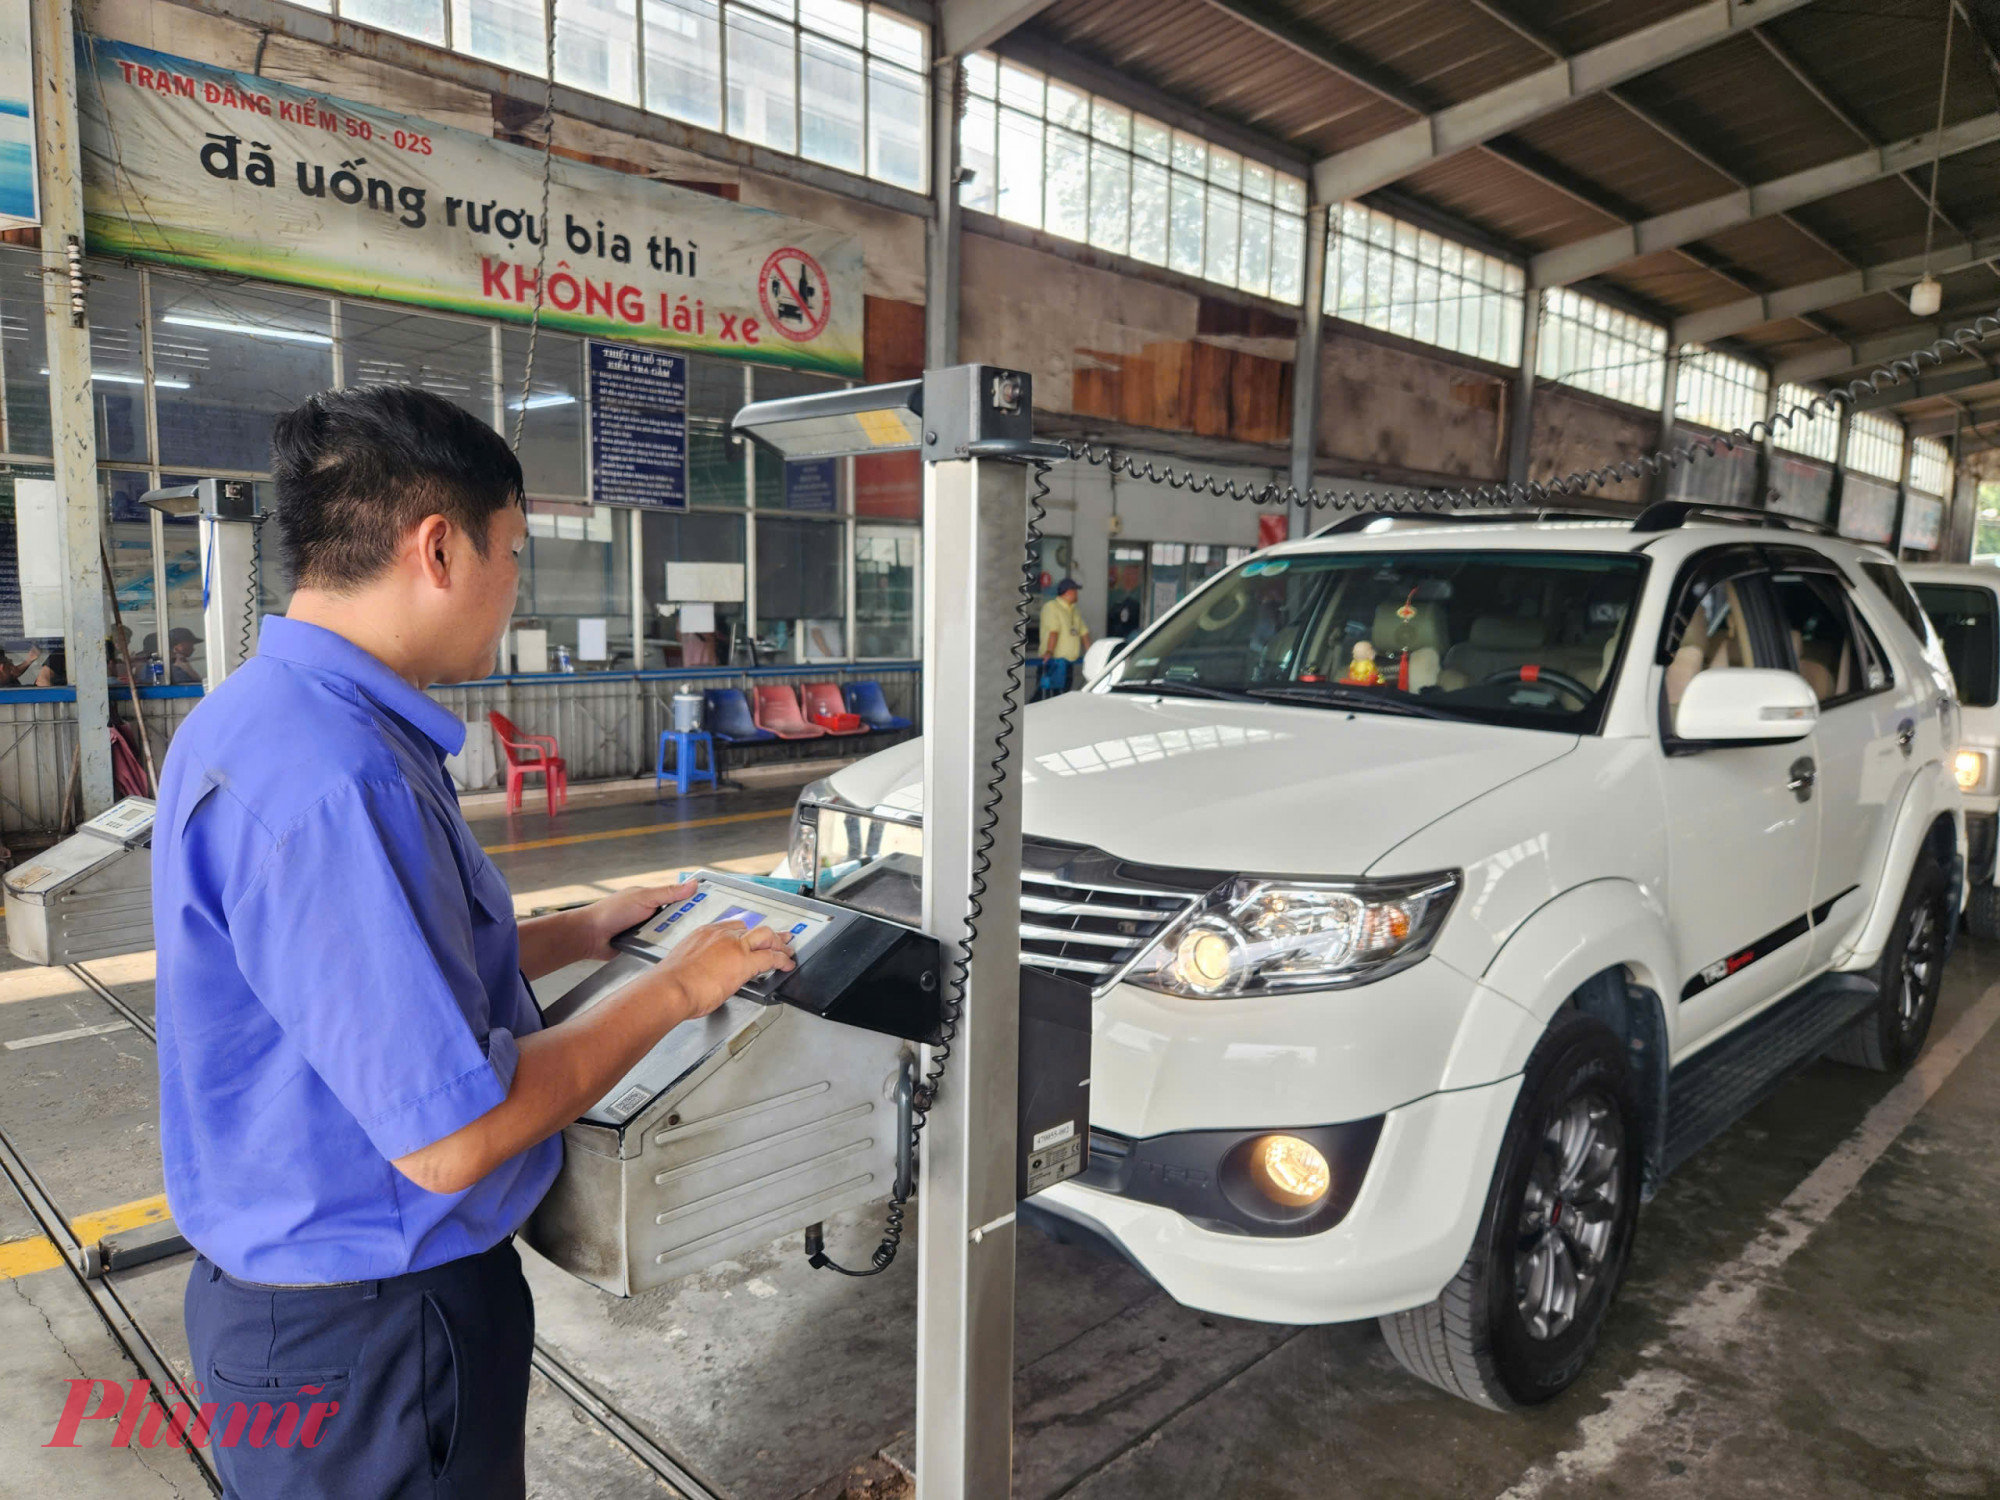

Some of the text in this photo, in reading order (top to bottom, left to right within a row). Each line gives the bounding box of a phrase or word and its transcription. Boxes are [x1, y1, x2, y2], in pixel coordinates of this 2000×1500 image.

[118, 60, 195, 98] TRẠM
[204, 79, 272, 117] ĐĂNG
[279, 97, 338, 133] KIỂM
[346, 117, 372, 141] 50
[394, 129, 433, 156] 02S
[200, 131, 698, 278] đã uống rượu bia thì
[481, 260, 761, 345] KHÔNG lái xe
